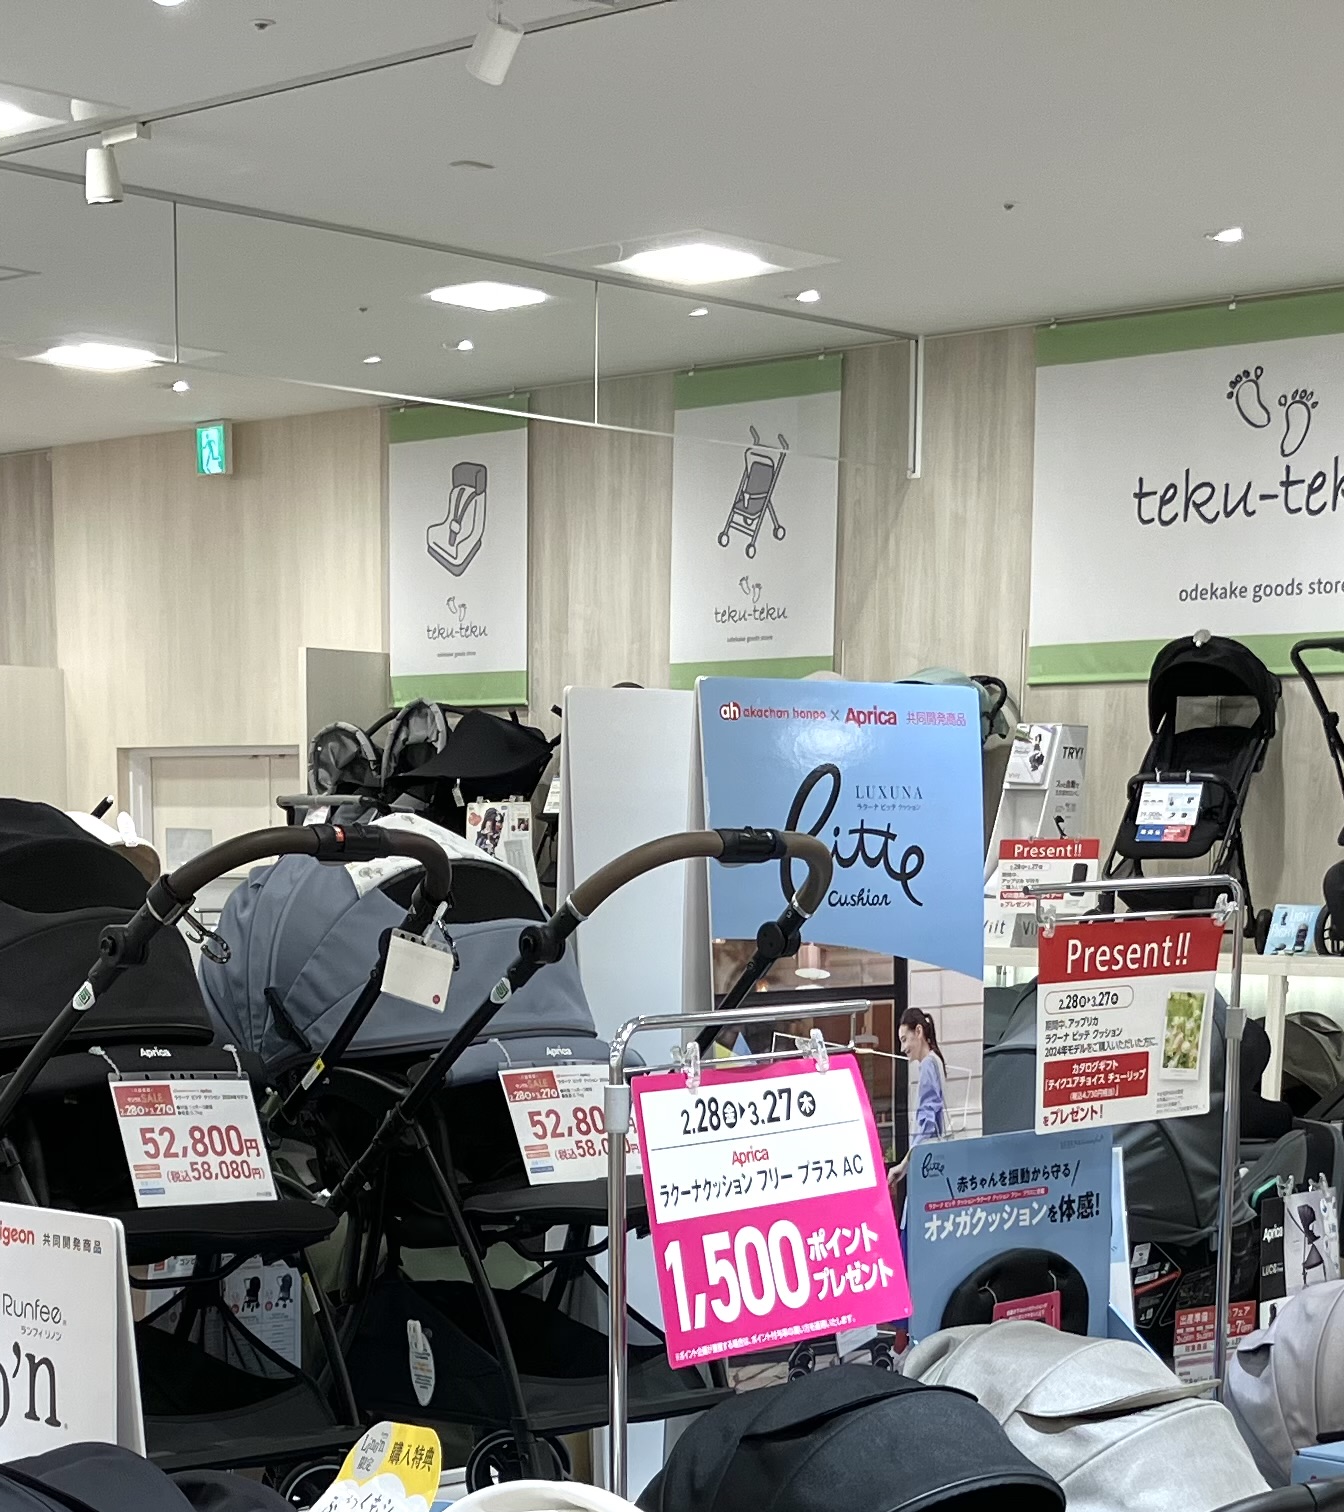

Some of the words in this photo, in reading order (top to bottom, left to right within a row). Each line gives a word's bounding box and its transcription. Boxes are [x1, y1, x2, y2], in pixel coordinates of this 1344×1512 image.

[1177, 579, 1248, 603] odekake
[1251, 576, 1302, 603] goods
[713, 603, 789, 626] teku-teku
[425, 621, 489, 641] teku-teku
[844, 705, 897, 728] Aprica
[855, 785, 923, 800] LUXUNA
[1013, 843, 1082, 858] Present!!
[827, 888, 892, 908] Cushion
[1066, 932, 1193, 974] Present!!
[1044, 1032, 1070, 1045] ラクーナ
[1092, 1027, 1124, 1040] クッション
[1071, 1059, 1119, 1074] カタログギフト
[1107, 1068, 1147, 1084] チューリップ
[138, 1124, 261, 1160] 52,800円
[731, 1145, 770, 1166] Aprica
[659, 1173, 754, 1209] ラクーナクッション
[757, 1167, 793, 1192] フリー
[800, 1158, 838, 1184] プラス
[843, 1153, 865, 1175] AC
[956, 1162, 1072, 1194] 赤ちゃんを振動から守る
[923, 1190, 1101, 1242] オメガクッションを体感!
[42, 1232, 102, 1255] 共同開発商品
[807, 1221, 879, 1262] ポイント
[663, 1219, 812, 1334] 1,500
[812, 1258, 895, 1301] プレゼント
